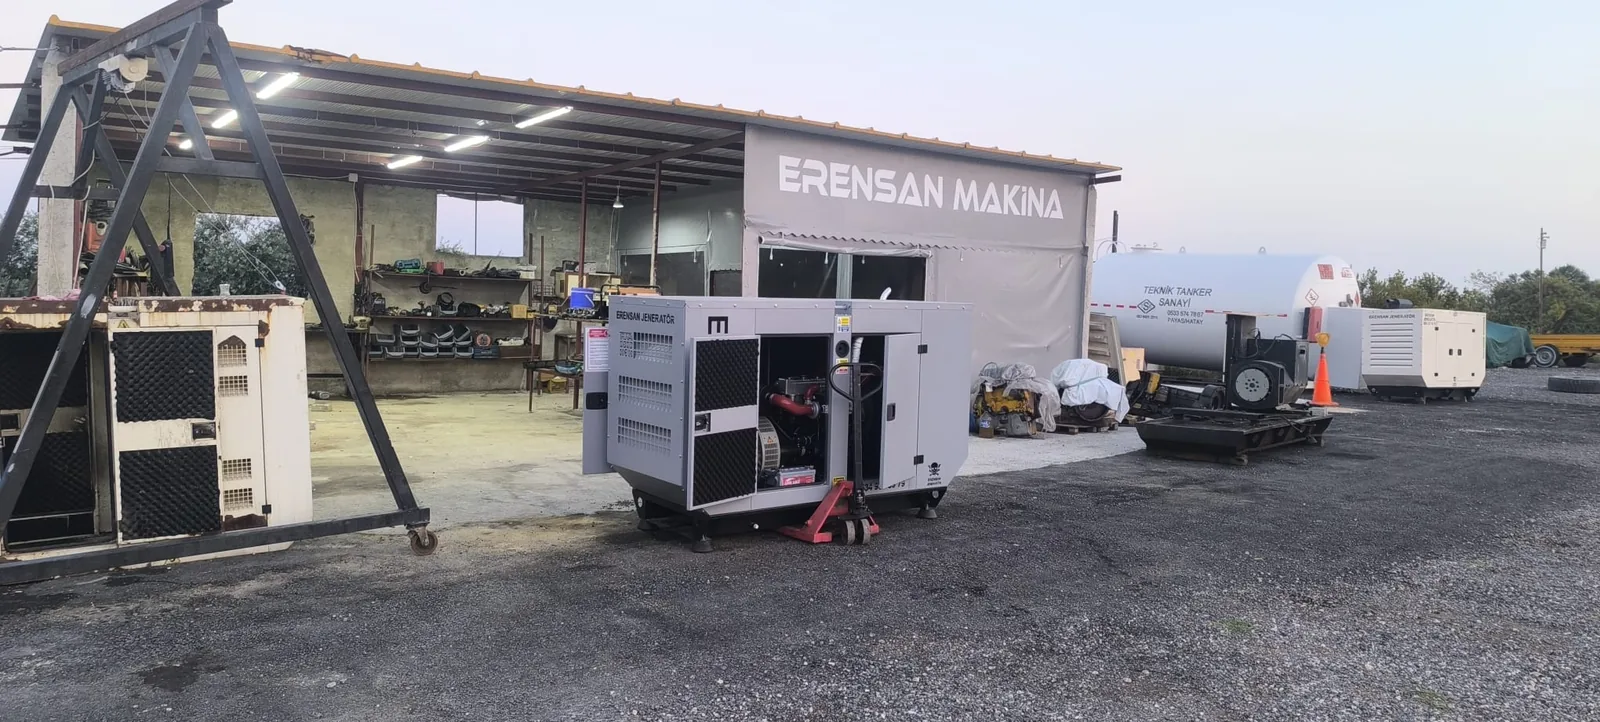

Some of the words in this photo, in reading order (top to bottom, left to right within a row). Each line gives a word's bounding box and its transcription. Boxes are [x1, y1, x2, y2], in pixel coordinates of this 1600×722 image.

[779, 155, 943, 208] ERENSAN
[953, 178, 1064, 219] MAKİNA
[1144, 285, 1174, 295] TEKNİK
[1176, 287, 1212, 296] TANKER
[1159, 298, 1191, 307] SANAYİ
[616, 310, 640, 321] ERENSAN
[641, 313, 675, 324] JENERATÖR
